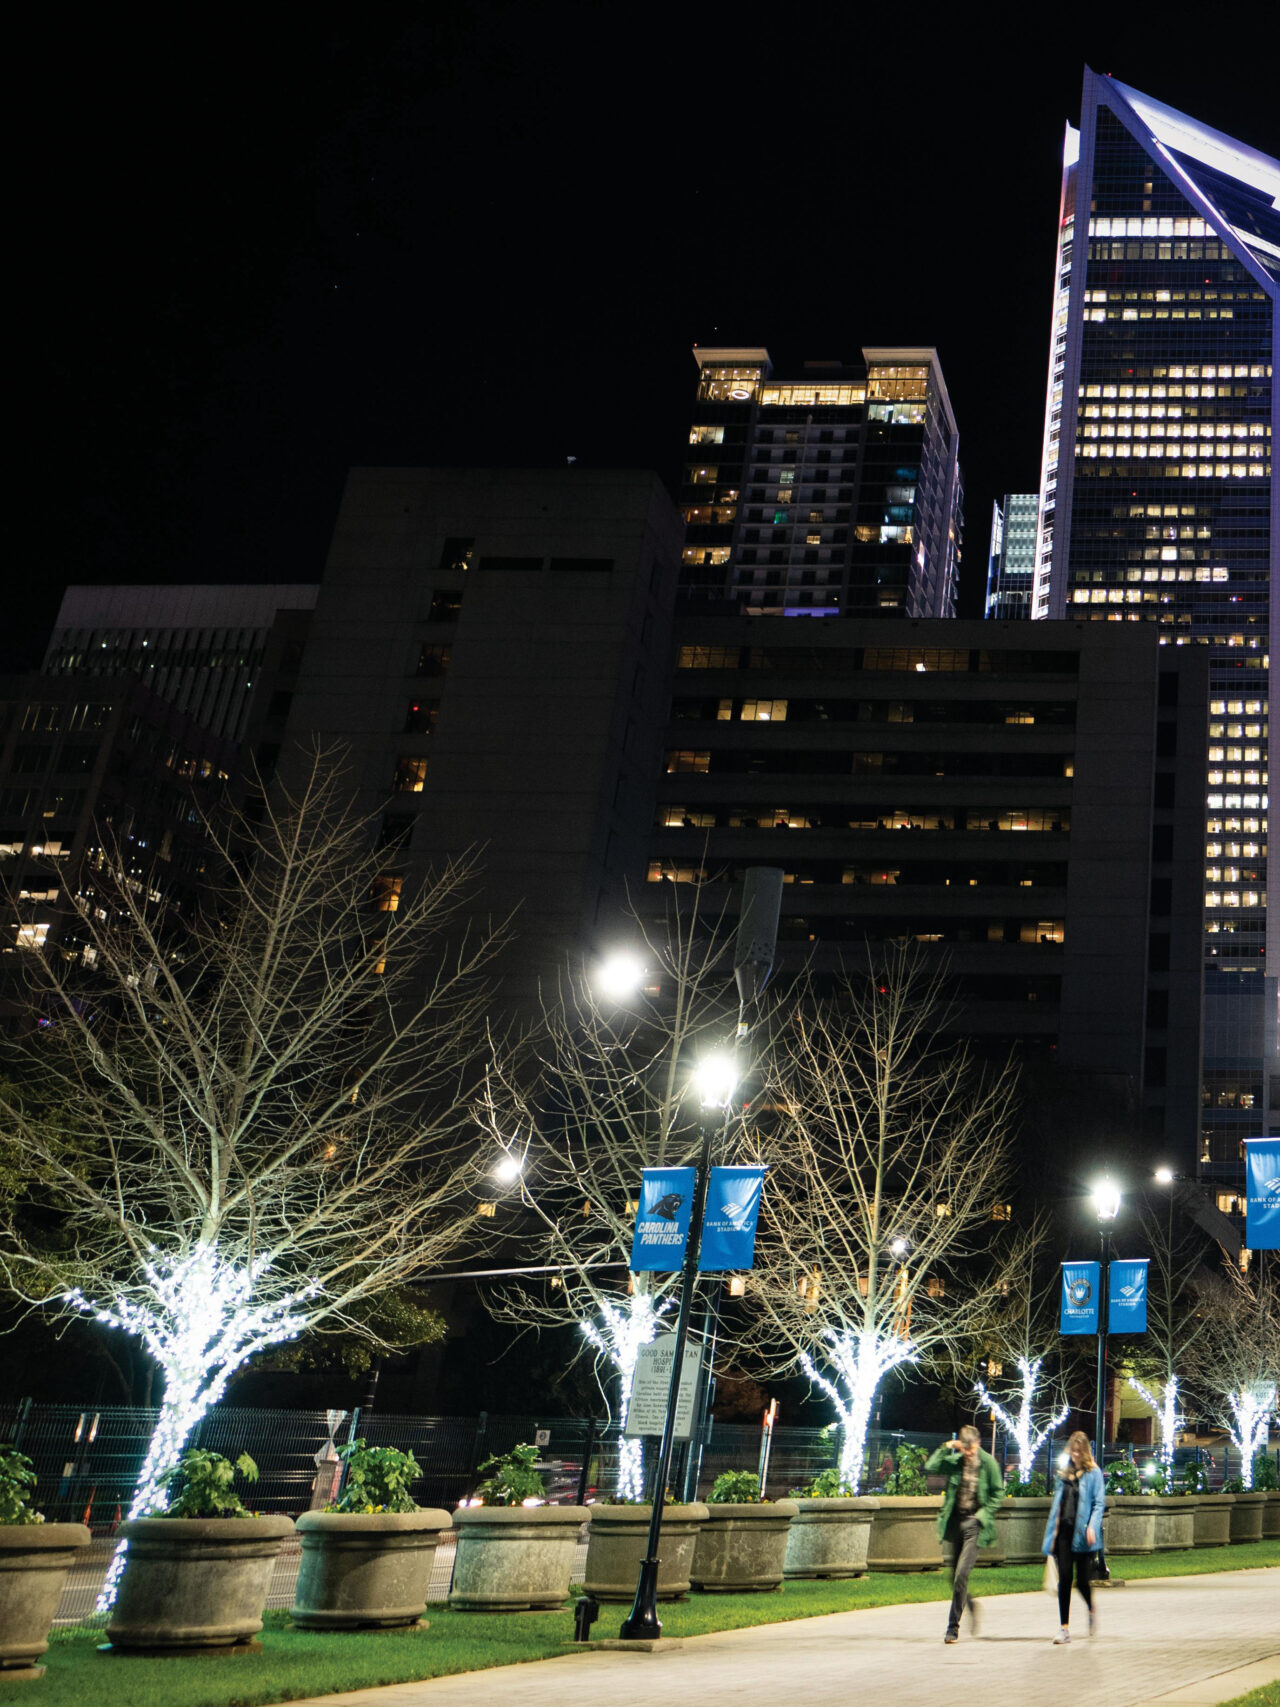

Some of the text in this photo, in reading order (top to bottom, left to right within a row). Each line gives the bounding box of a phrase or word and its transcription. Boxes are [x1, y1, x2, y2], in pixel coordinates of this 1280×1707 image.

[637, 1221, 679, 1233] CAROLINA
[640, 1233, 684, 1245] PANTHERS
[641, 1349, 658, 1358] GOOD
